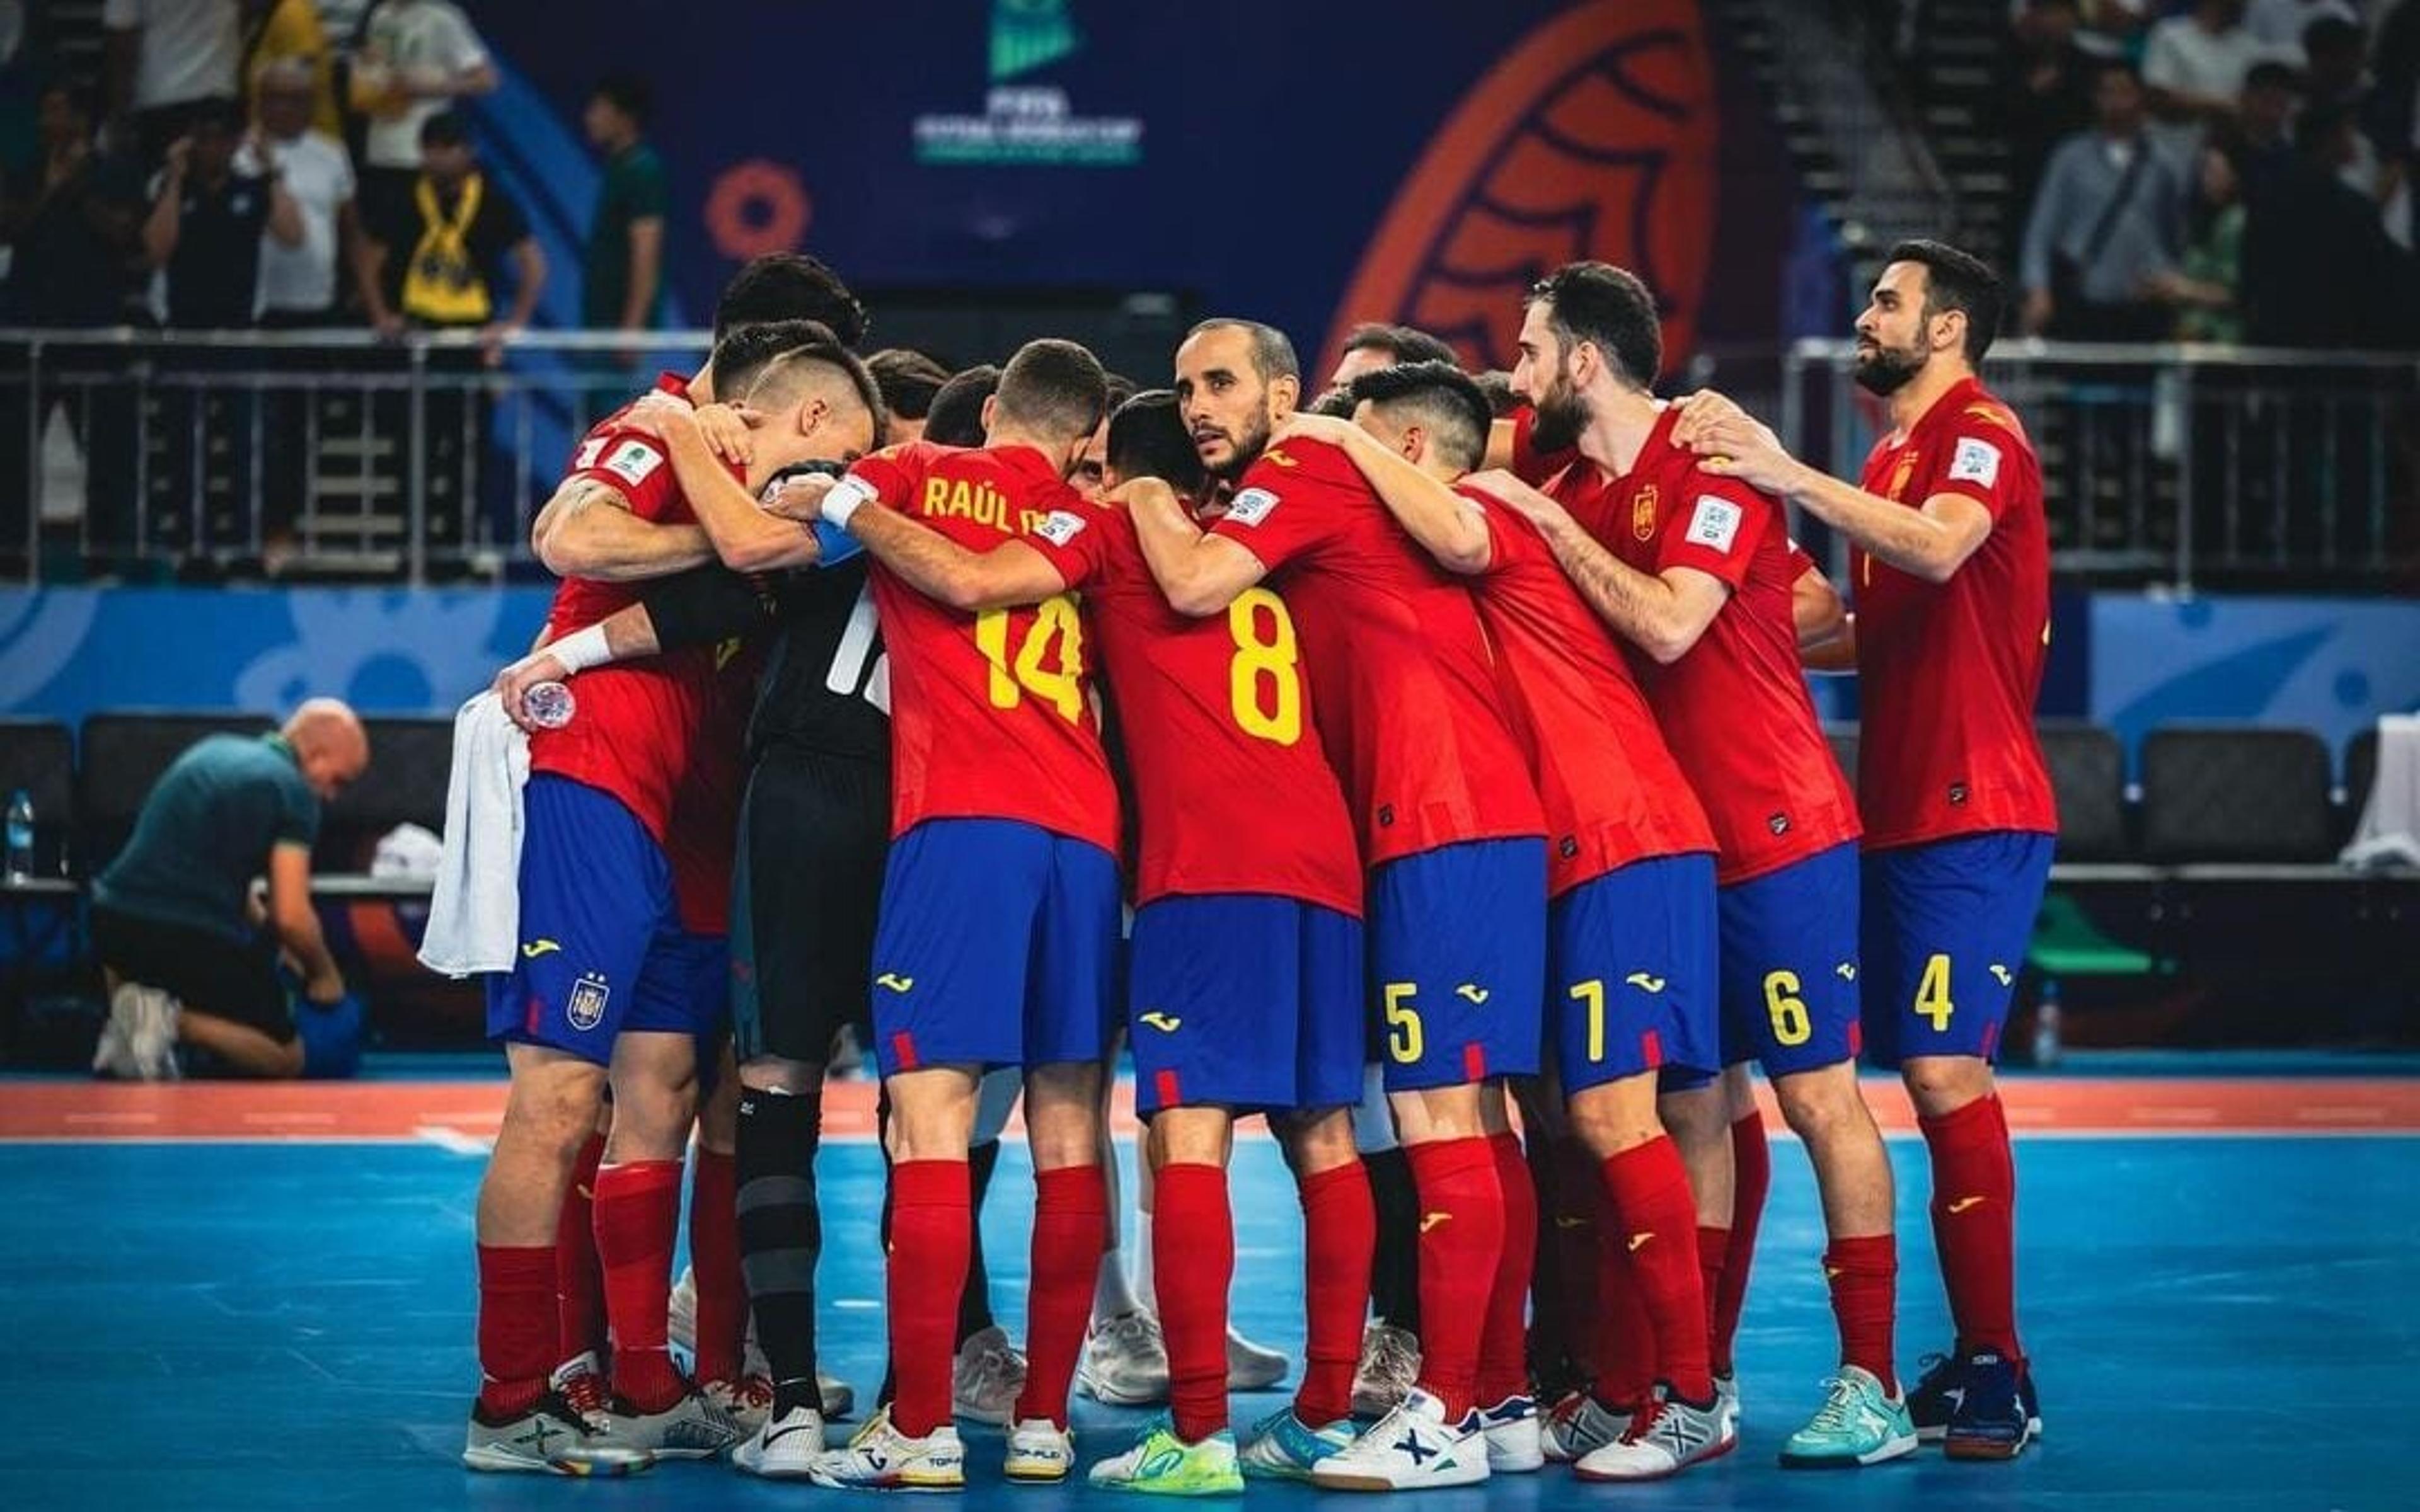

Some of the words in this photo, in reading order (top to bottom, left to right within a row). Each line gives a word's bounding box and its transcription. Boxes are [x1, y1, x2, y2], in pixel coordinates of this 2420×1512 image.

[923, 477, 1013, 534] RAÚL
[976, 595, 1083, 728] 14
[1230, 587, 1301, 746] 8
[1385, 982, 1423, 1063] 5
[1570, 980, 1603, 1062] 7
[1763, 970, 1811, 1046] 6
[1915, 954, 1953, 1031] 4
